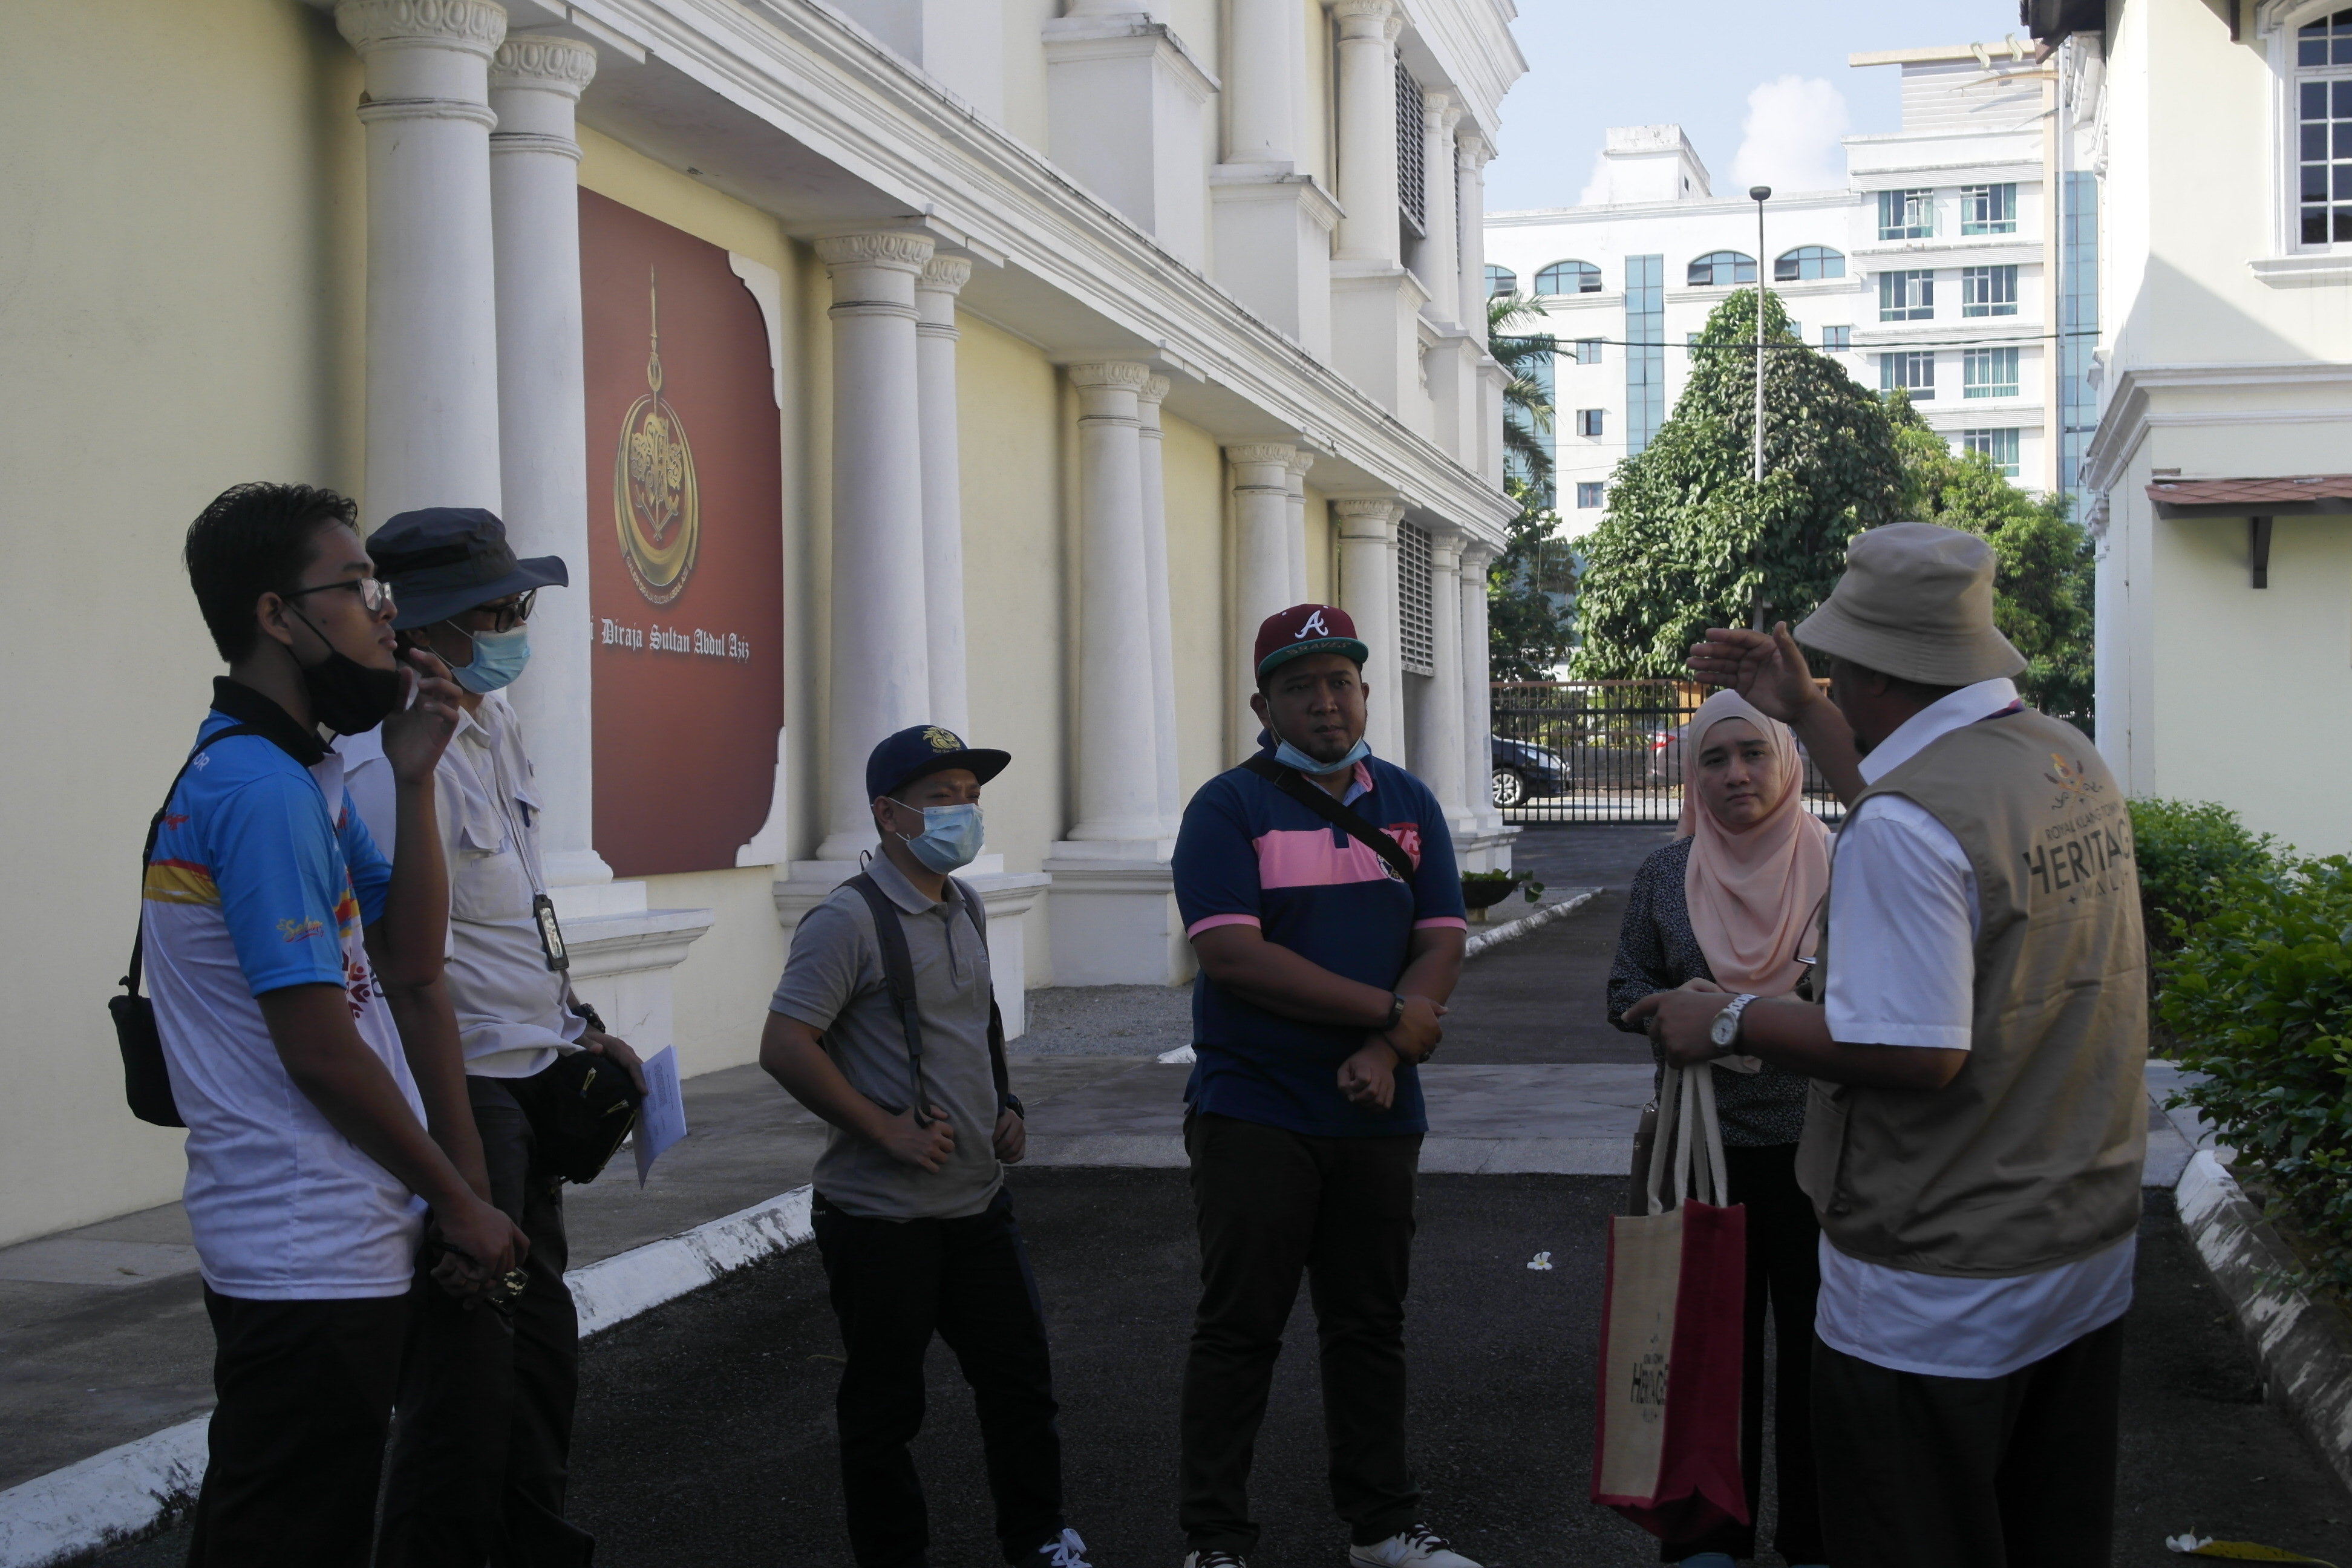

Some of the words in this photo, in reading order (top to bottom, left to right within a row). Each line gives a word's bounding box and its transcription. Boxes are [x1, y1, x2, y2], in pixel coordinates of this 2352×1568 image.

[1295, 610, 1329, 639] A
[601, 617, 643, 652] Diraja
[649, 624, 690, 653] Sultan
[694, 628, 725, 656] Abdul
[728, 632, 750, 664] Aziz
[1286, 641, 1351, 655] BRAVES
[2045, 820, 2076, 841] ROYAL
[2076, 808, 2102, 829] KLANG
[2022, 814, 2130, 894] HERITAG
[2082, 874, 2125, 899] WAL
